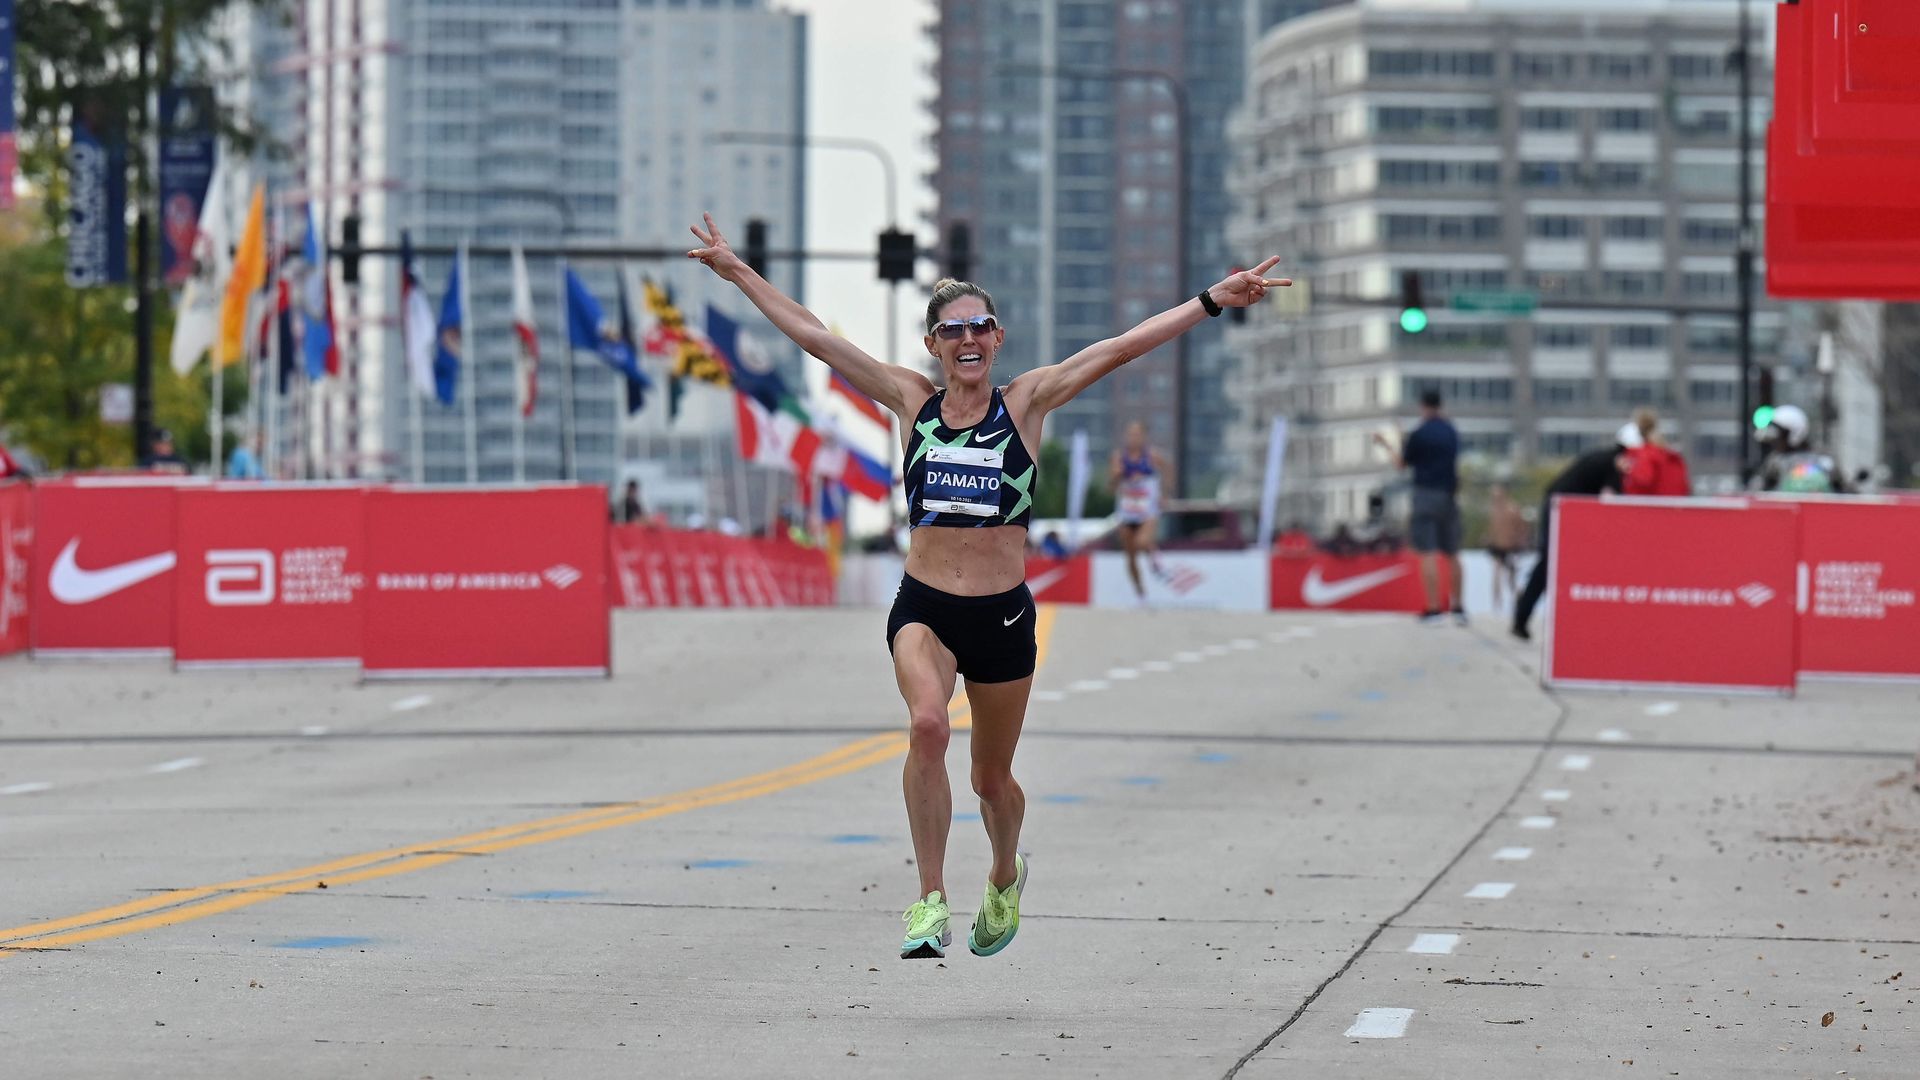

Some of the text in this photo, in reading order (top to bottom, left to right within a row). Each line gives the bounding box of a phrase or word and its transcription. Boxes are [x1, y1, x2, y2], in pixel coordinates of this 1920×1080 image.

[66, 142, 96, 288] CHICAGO
[926, 471, 1000, 491] D'AMATO
[281, 561, 343, 576] WORLD
[281, 573, 366, 590] MARATHO
[377, 572, 542, 590] BANK OF AMERICA
[1815, 576, 1877, 590] WORLD
[281, 589, 353, 603] MAJORS
[1570, 584, 1735, 606] BANK OF AMERICA
[1814, 604, 1886, 619] MAJORS
